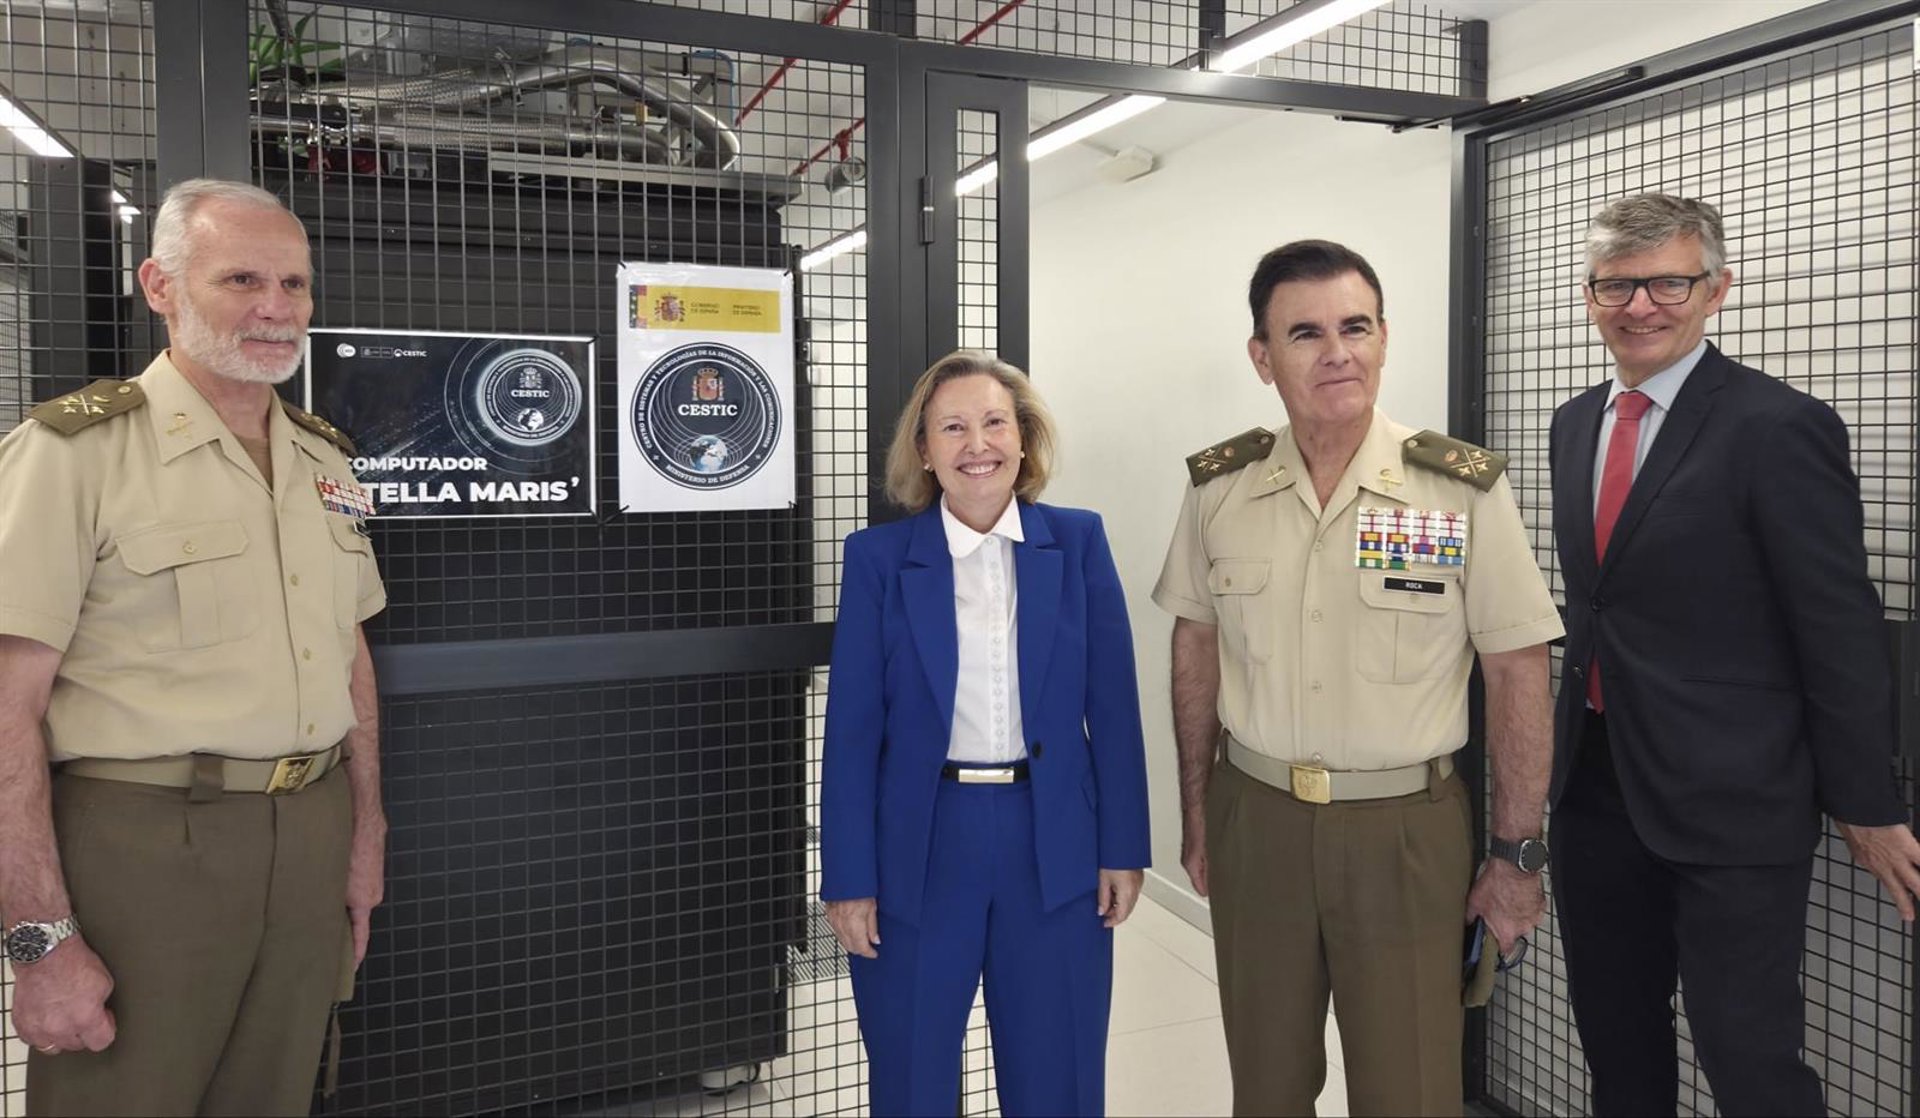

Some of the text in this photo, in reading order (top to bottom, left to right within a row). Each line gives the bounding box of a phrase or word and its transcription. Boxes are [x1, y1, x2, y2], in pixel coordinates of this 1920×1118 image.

[657, 351, 697, 375] TECNOLOGÍAS
[718, 351, 757, 377] INFORMACIÓN
[511, 389, 550, 398] CESTIC
[638, 379, 654, 410] SISTEMAS
[758, 380, 768, 392] LAS
[678, 404, 738, 416] CESTIC
[639, 422, 652, 449] CENTRO
[666, 464, 706, 483] MINISTERIO
[719, 464, 750, 482] DEFENSA
[359, 482, 462, 503] TELLA
[1405, 582, 1423, 590] ROCA
